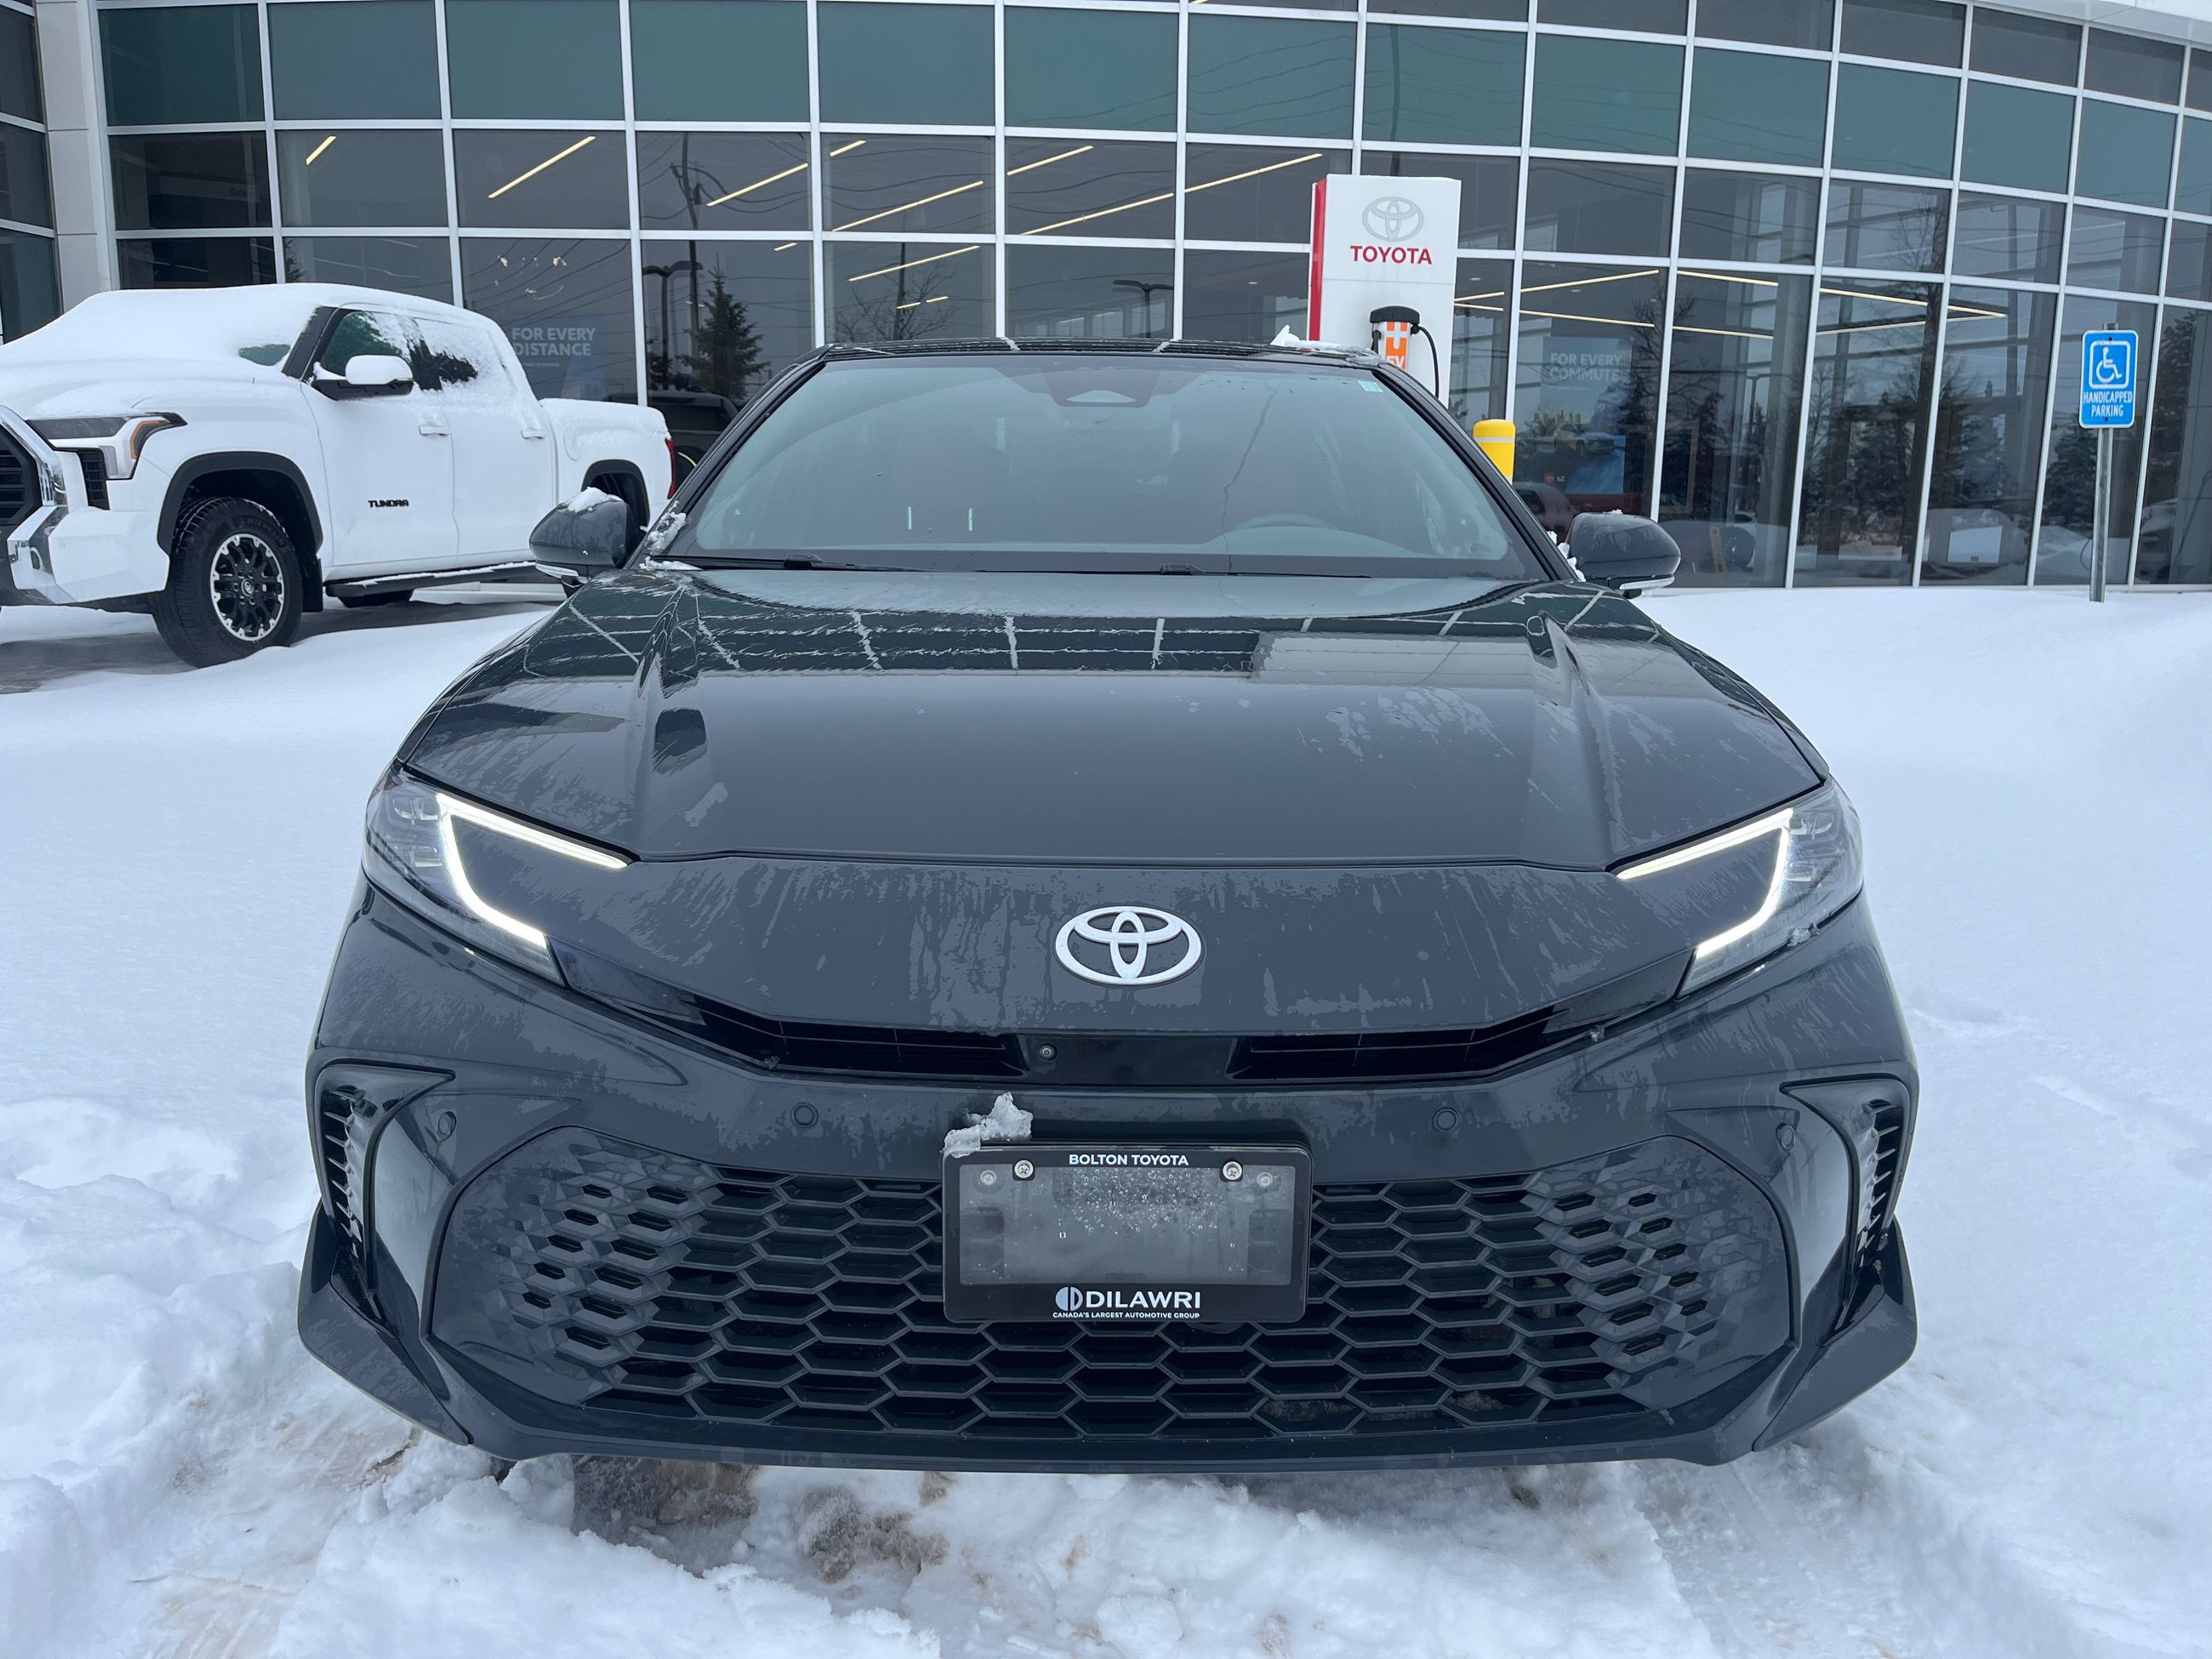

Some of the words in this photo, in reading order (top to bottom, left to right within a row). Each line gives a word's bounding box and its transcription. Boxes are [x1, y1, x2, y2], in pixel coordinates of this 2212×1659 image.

[1350, 245, 1432, 265] TOYOTA
[512, 328, 544, 340] FOR
[547, 328, 596, 340] EVERY
[513, 343, 592, 356] DISTANCE
[1550, 353, 1577, 366] FOR
[1580, 353, 1622, 366] EVERY
[1549, 366, 1620, 381] COMMUTE
[2083, 391, 2133, 404] HANDICAPPED
[2091, 404, 2124, 417] PARKING
[368, 499, 409, 508] TUNDRA
[1069, 1154, 1128, 1166] BOLTON
[1131, 1154, 1189, 1166] TOYOTA
[1086, 1291, 1200, 1308] DILAWRI
